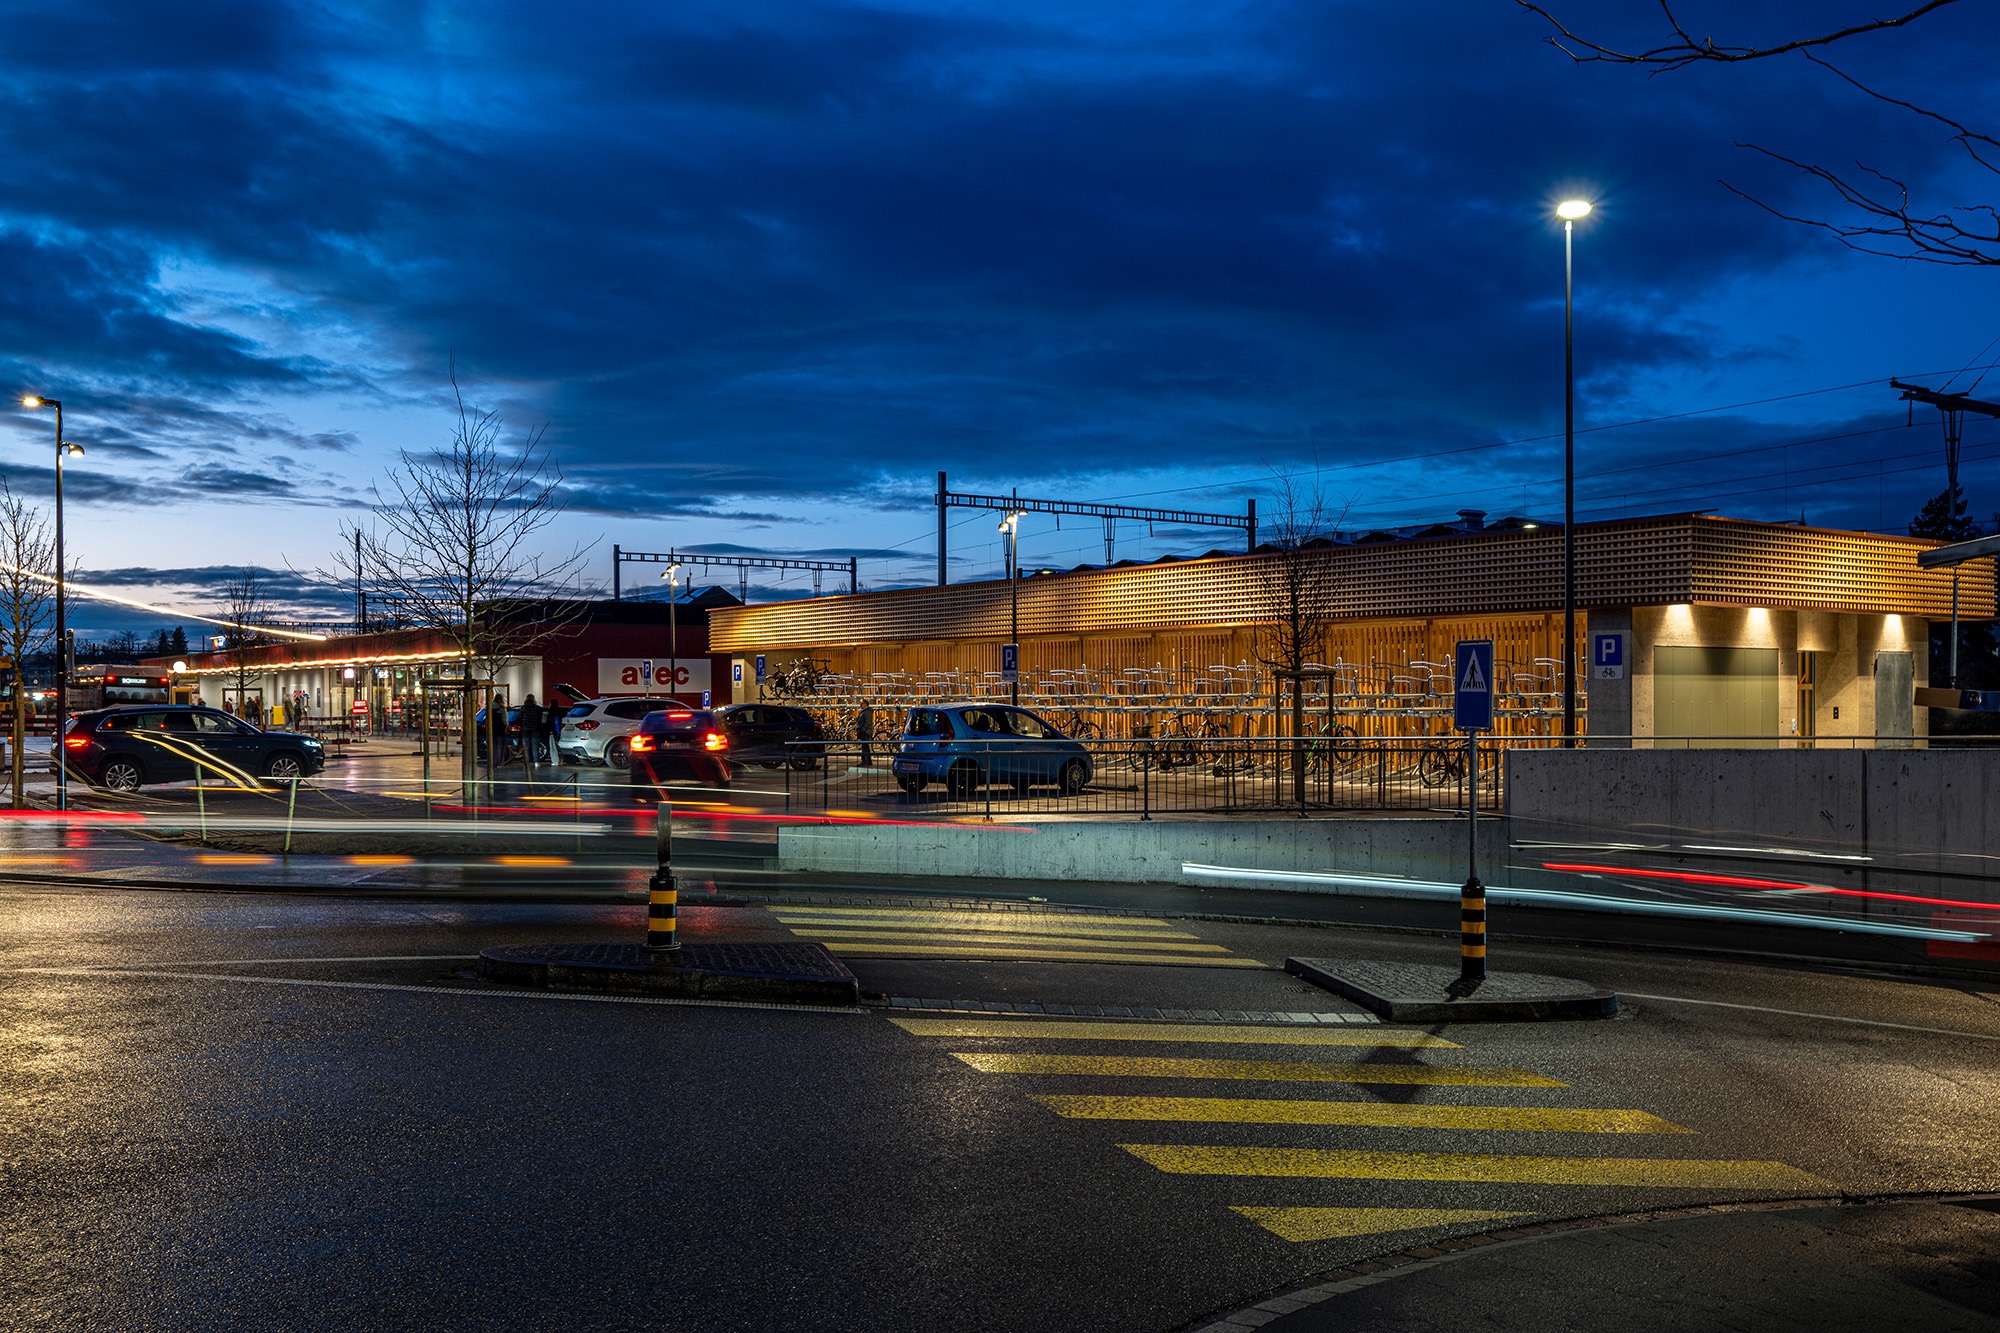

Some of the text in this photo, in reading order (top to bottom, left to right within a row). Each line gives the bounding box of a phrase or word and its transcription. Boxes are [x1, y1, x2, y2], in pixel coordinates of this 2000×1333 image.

[1602, 638, 1615, 662] P
[1005, 649, 1013, 667] P
[645, 663, 650, 677] P
[735, 666, 740, 679] P
[758, 659, 763, 673] P
[704, 692, 709, 705] P
